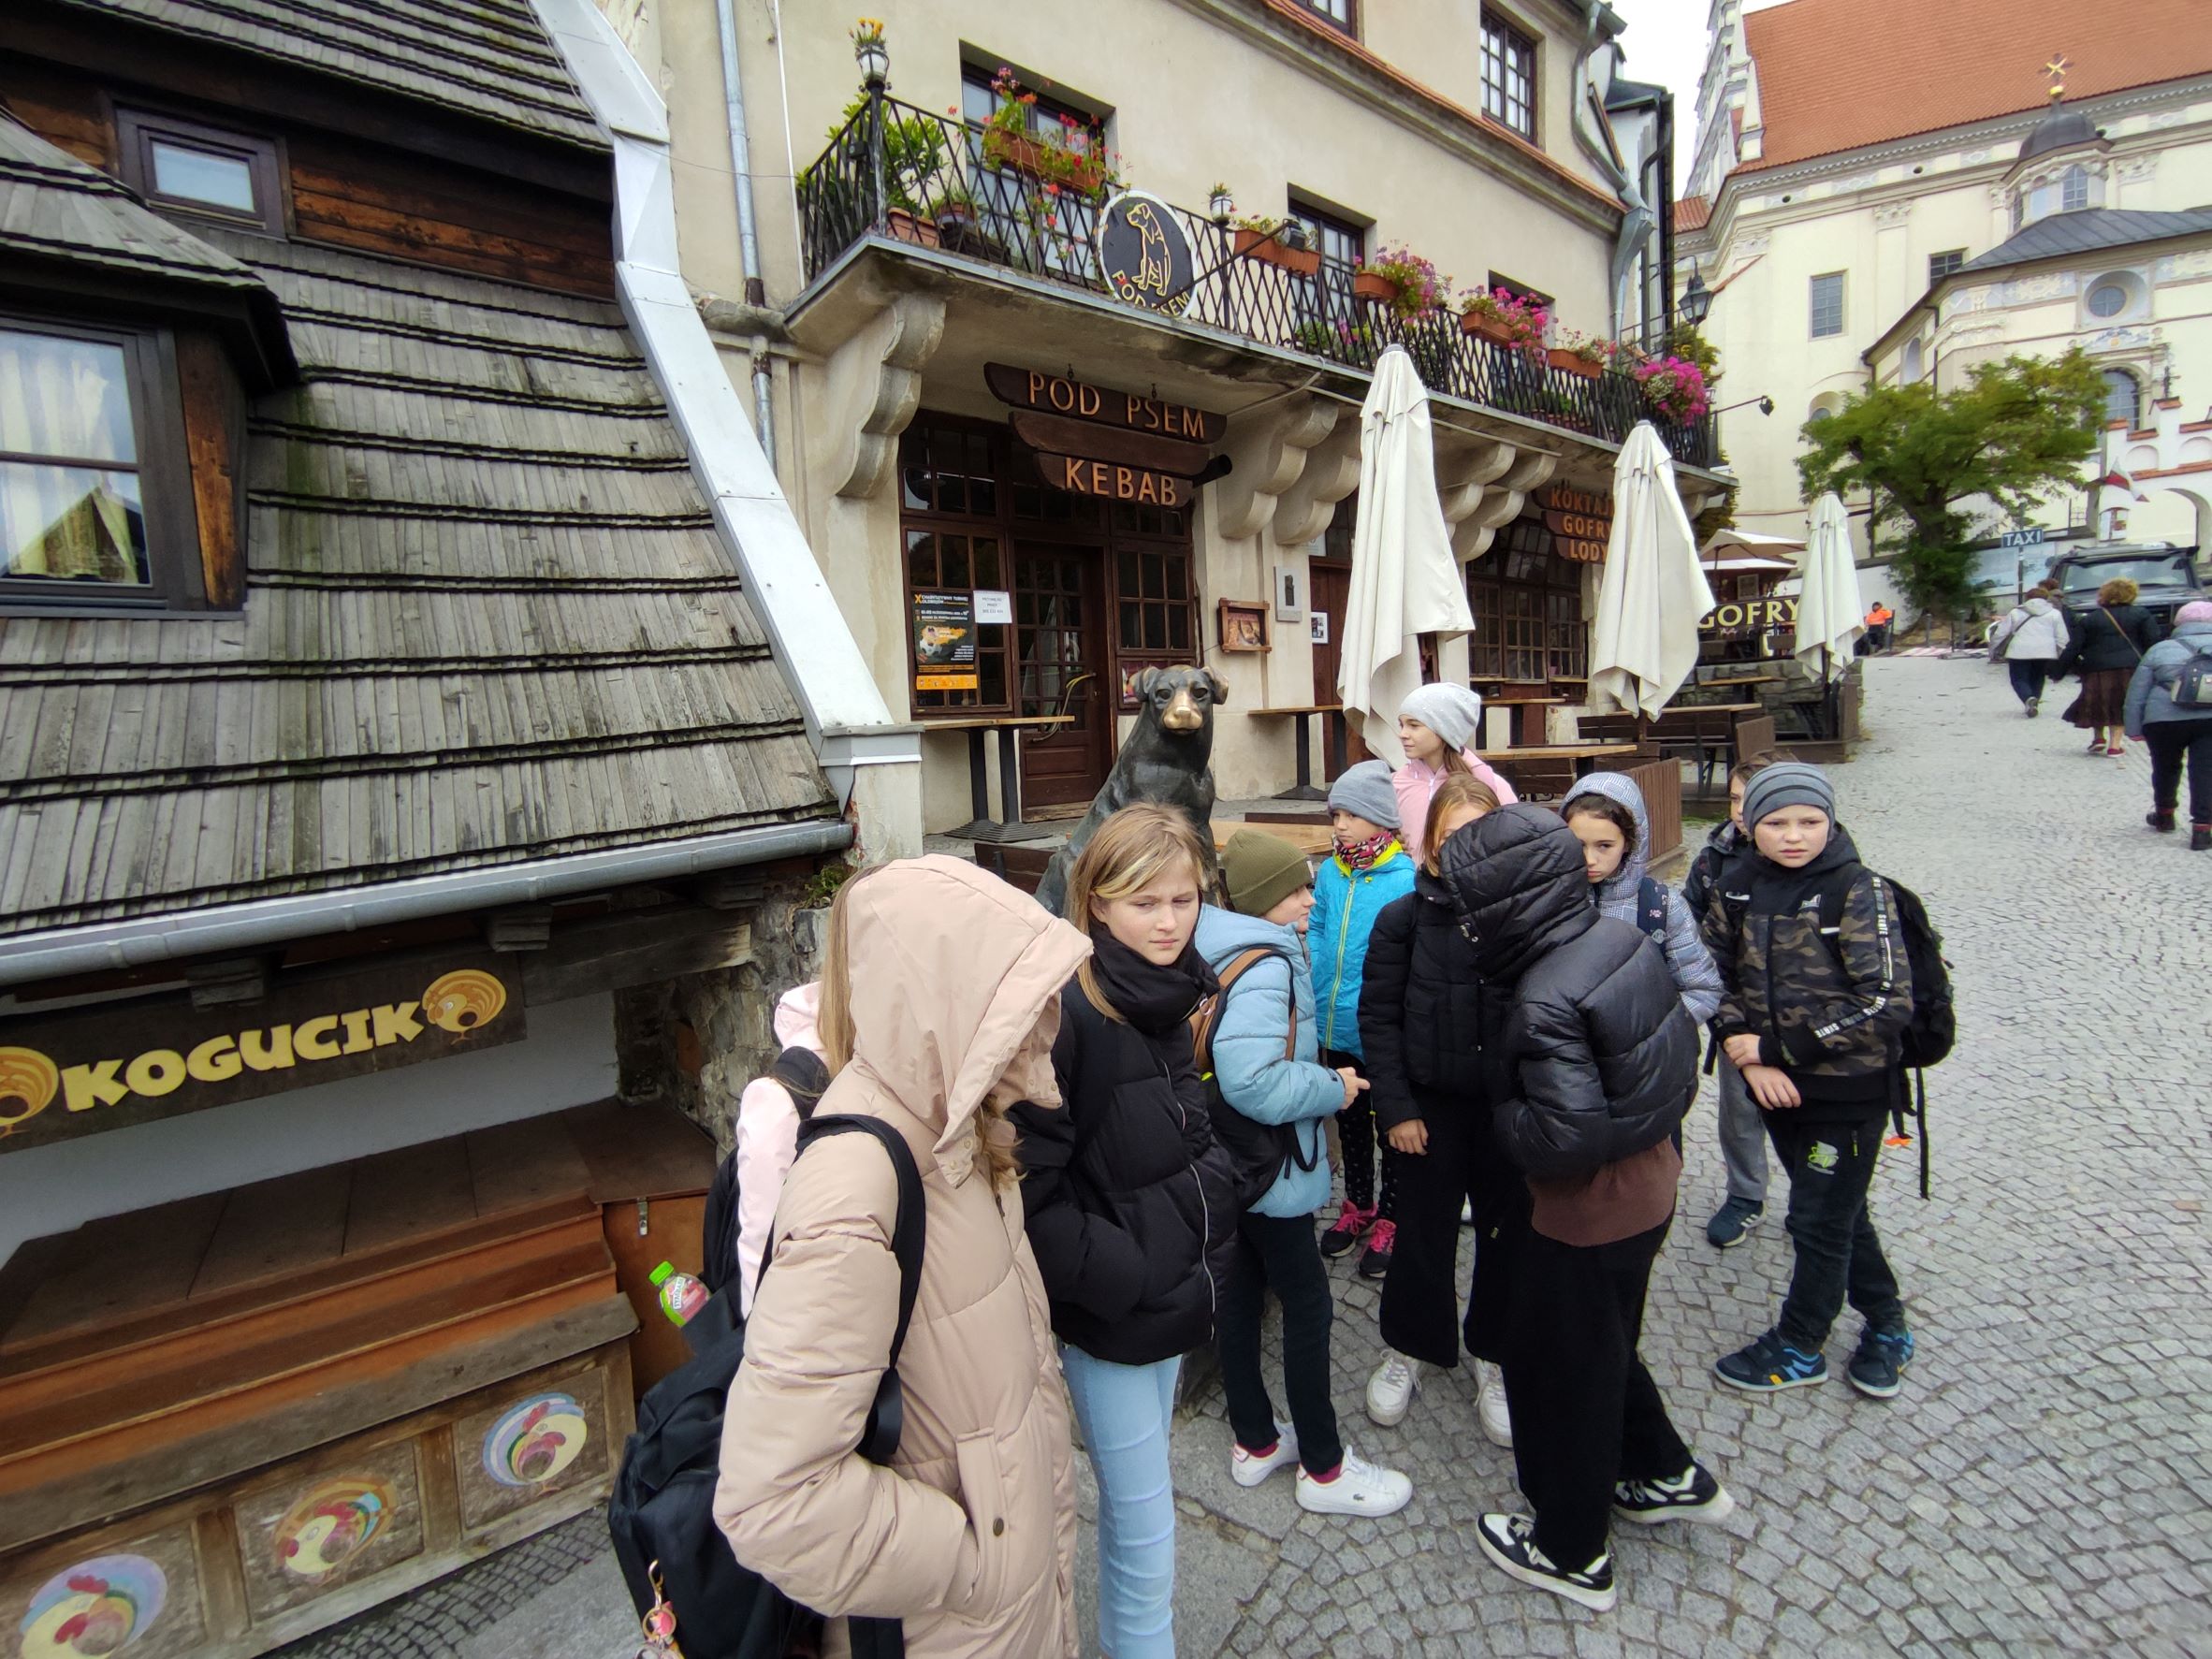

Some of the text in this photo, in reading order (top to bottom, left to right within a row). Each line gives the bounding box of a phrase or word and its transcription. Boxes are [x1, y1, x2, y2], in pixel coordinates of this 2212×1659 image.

[1029, 371, 1205, 440] POD PSEM
[1065, 457, 1177, 506] KEBAB
[1569, 539, 1608, 562] LODY
[2004, 530, 2041, 546] TAXI
[60, 1000, 426, 1113] KOGUCIK
